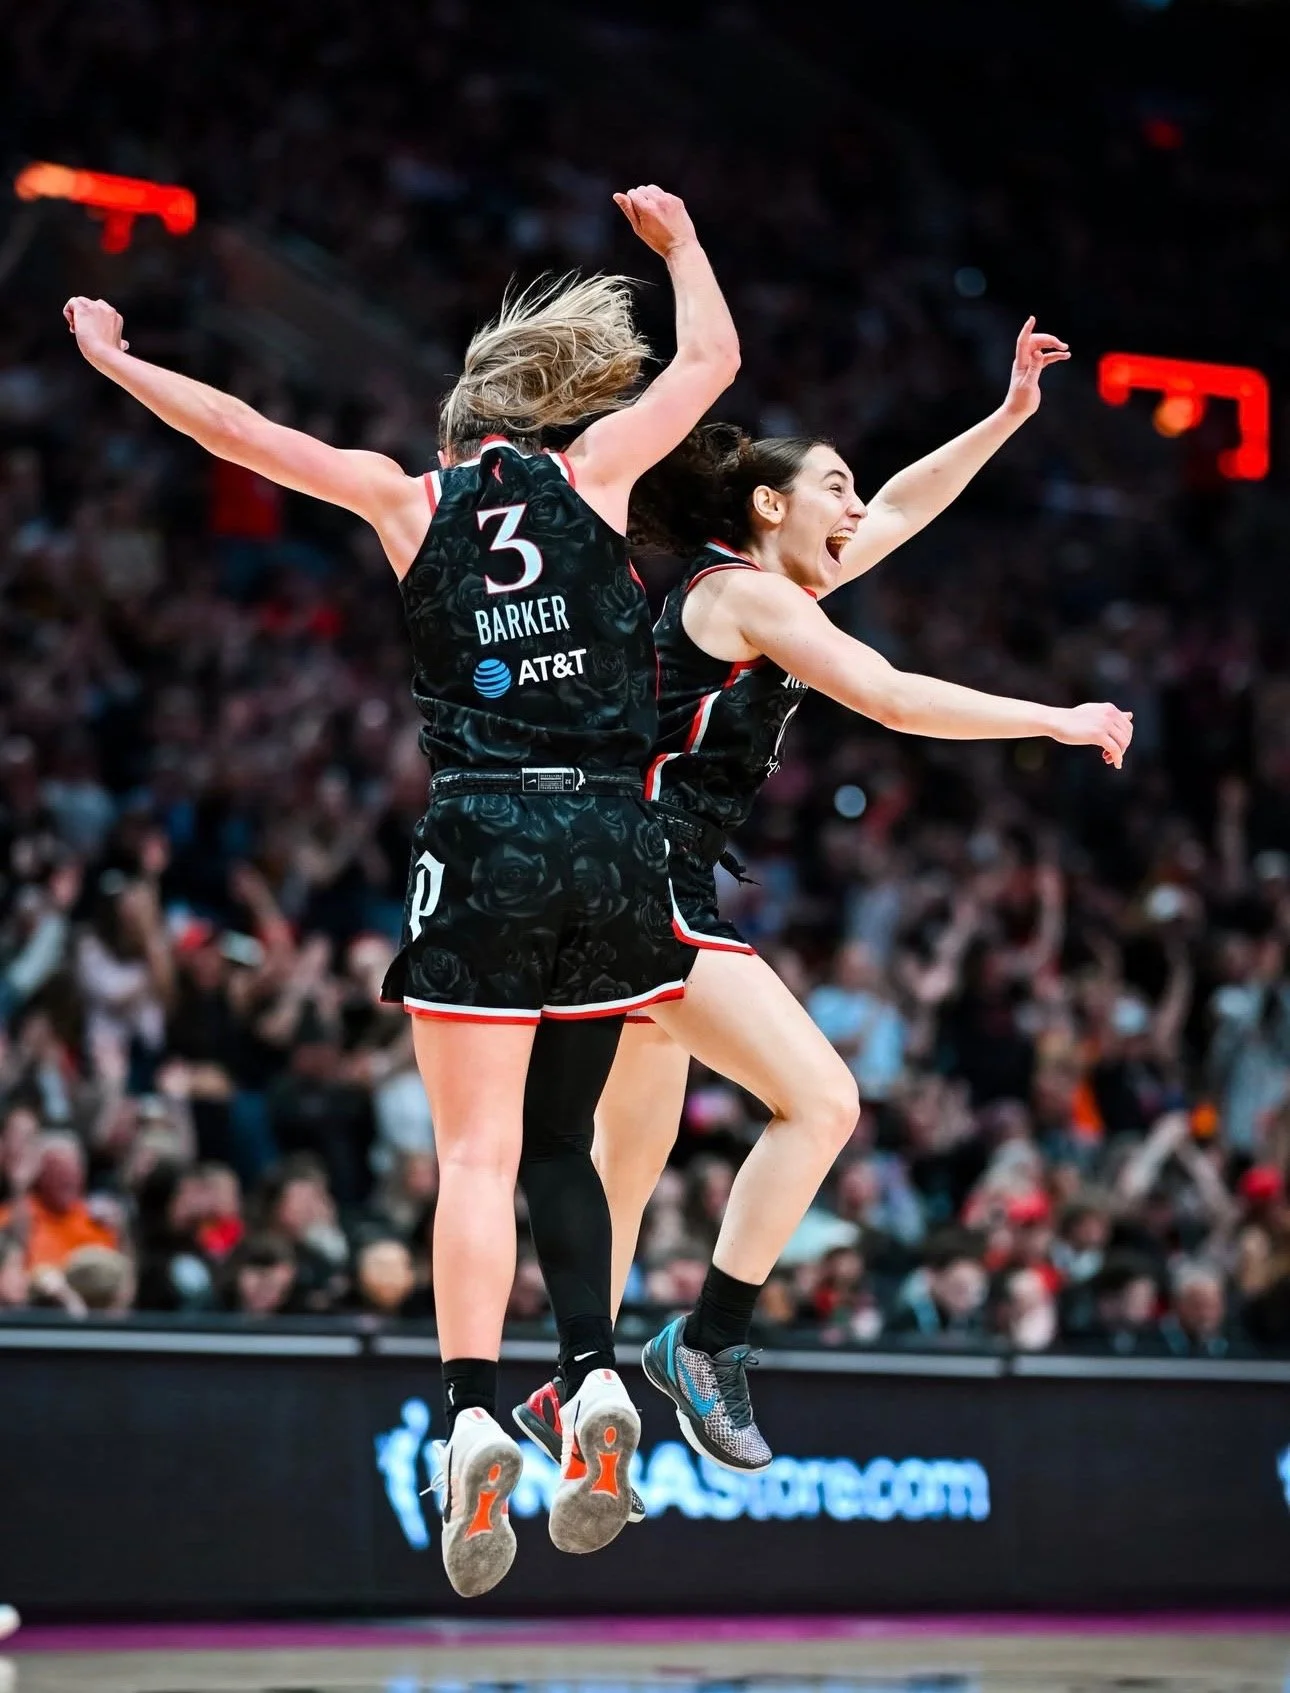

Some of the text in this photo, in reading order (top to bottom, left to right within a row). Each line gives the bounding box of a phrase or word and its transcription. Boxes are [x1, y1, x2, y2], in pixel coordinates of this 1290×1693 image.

[476, 502, 544, 595] 3
[474, 595, 570, 645] BARKER
[518, 648, 587, 685] AT&T
